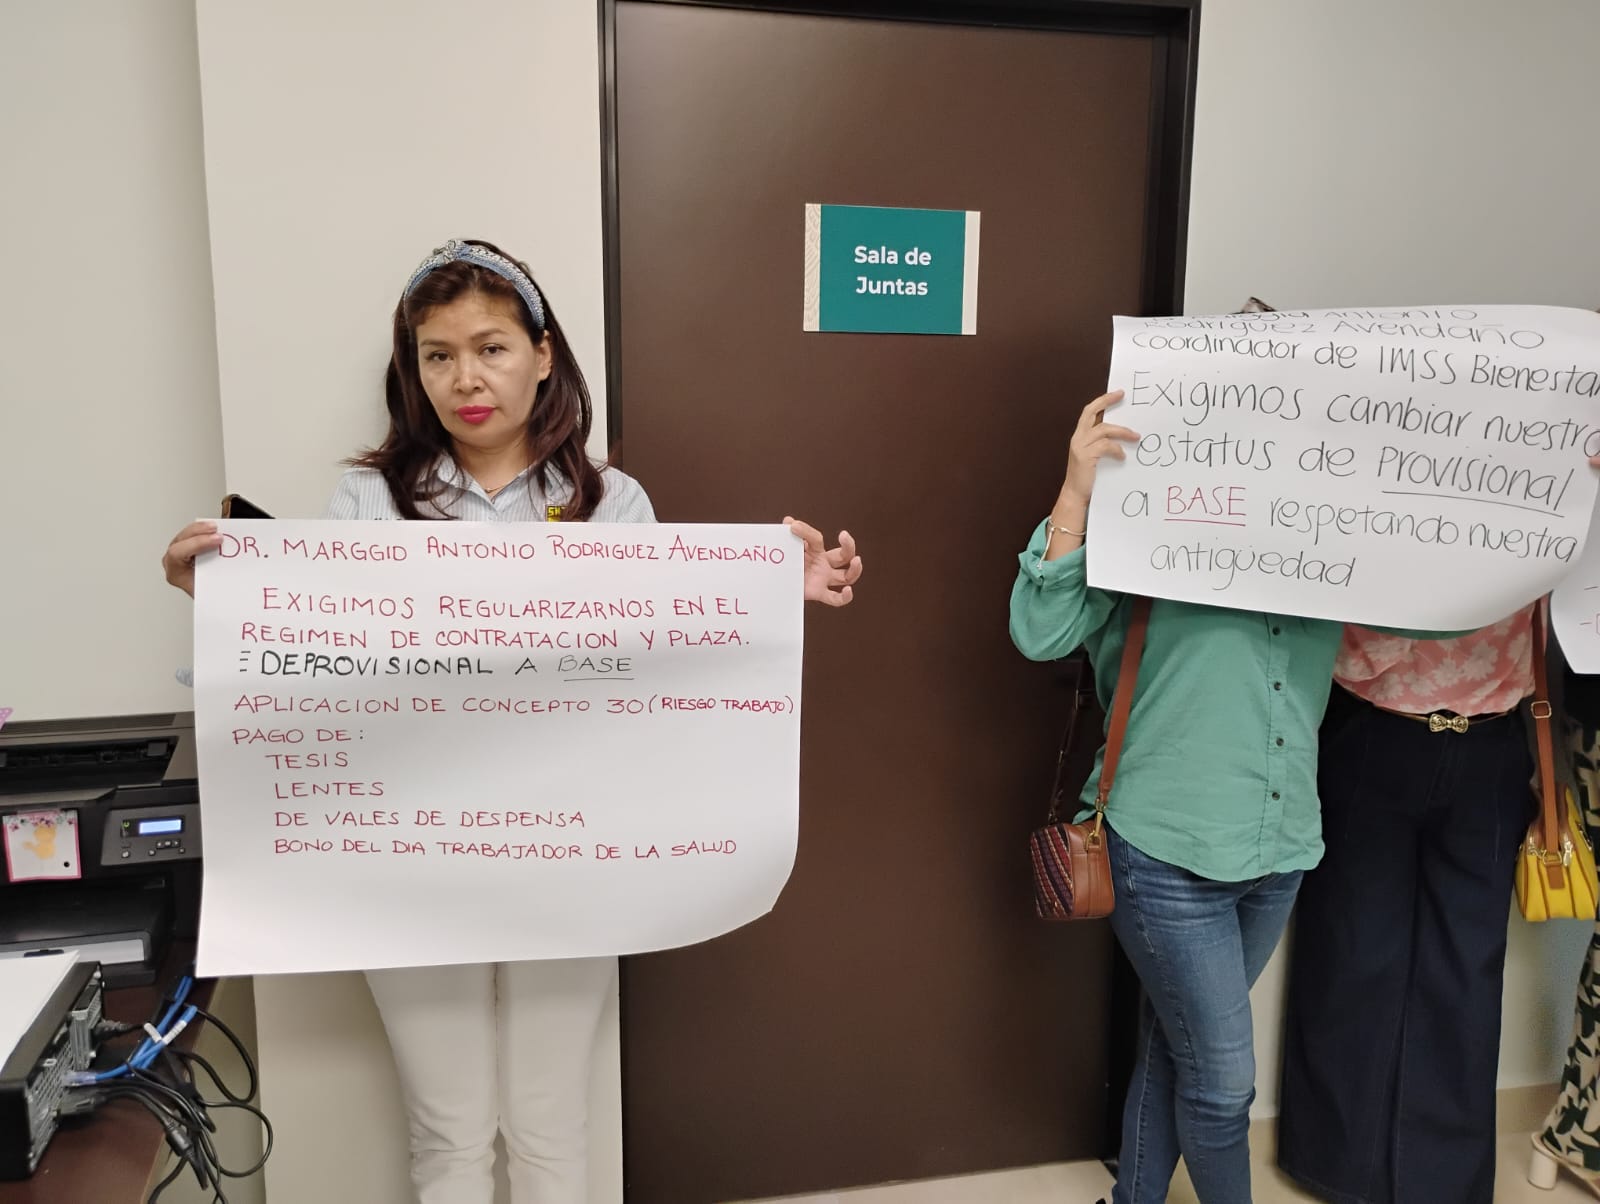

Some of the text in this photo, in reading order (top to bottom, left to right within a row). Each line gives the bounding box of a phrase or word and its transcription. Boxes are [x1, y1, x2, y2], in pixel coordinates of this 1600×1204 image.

[854, 245, 932, 266] Sala de
[855, 276, 929, 296] Juntas
[1333, 320, 1545, 350] Avendaño
[1132, 332, 1302, 361] Coordinador
[1314, 341, 1358, 369] de
[1379, 345, 1457, 385] IMSS
[1131, 370, 1305, 426] Exigimos
[1327, 396, 1473, 438] cambiar
[1136, 430, 1276, 472] estatus
[1299, 440, 1356, 477] de
[1121, 485, 1578, 563] a BASE respetando nuestra
[218, 533, 785, 565] DR. MARGGID ANTONIO RODRIGUEZ AVENDAÑO
[1150, 537, 1357, 591] antigüedad
[263, 587, 749, 621] EXIGIMOS REGULARIZARNOS EN EL
[241, 622, 750, 651] REGIMEN DE CONTRATACION Y PLAZA.
[515, 656, 538, 676] A
[557, 654, 633, 673] BASE
[233, 694, 400, 714] APLICACION
[412, 697, 447, 713] DE
[462, 697, 591, 715] CONCEPTO
[720, 695, 794, 715] TRABAJO)
[231, 728, 304, 745] PAGO
[265, 751, 349, 771] TESIS
[274, 781, 385, 800] LENTES
[274, 810, 585, 828] DE VALES DE DESPENSA
[274, 838, 738, 860] BONO DEL DIA TRABAJADOR DE LA SALUD
